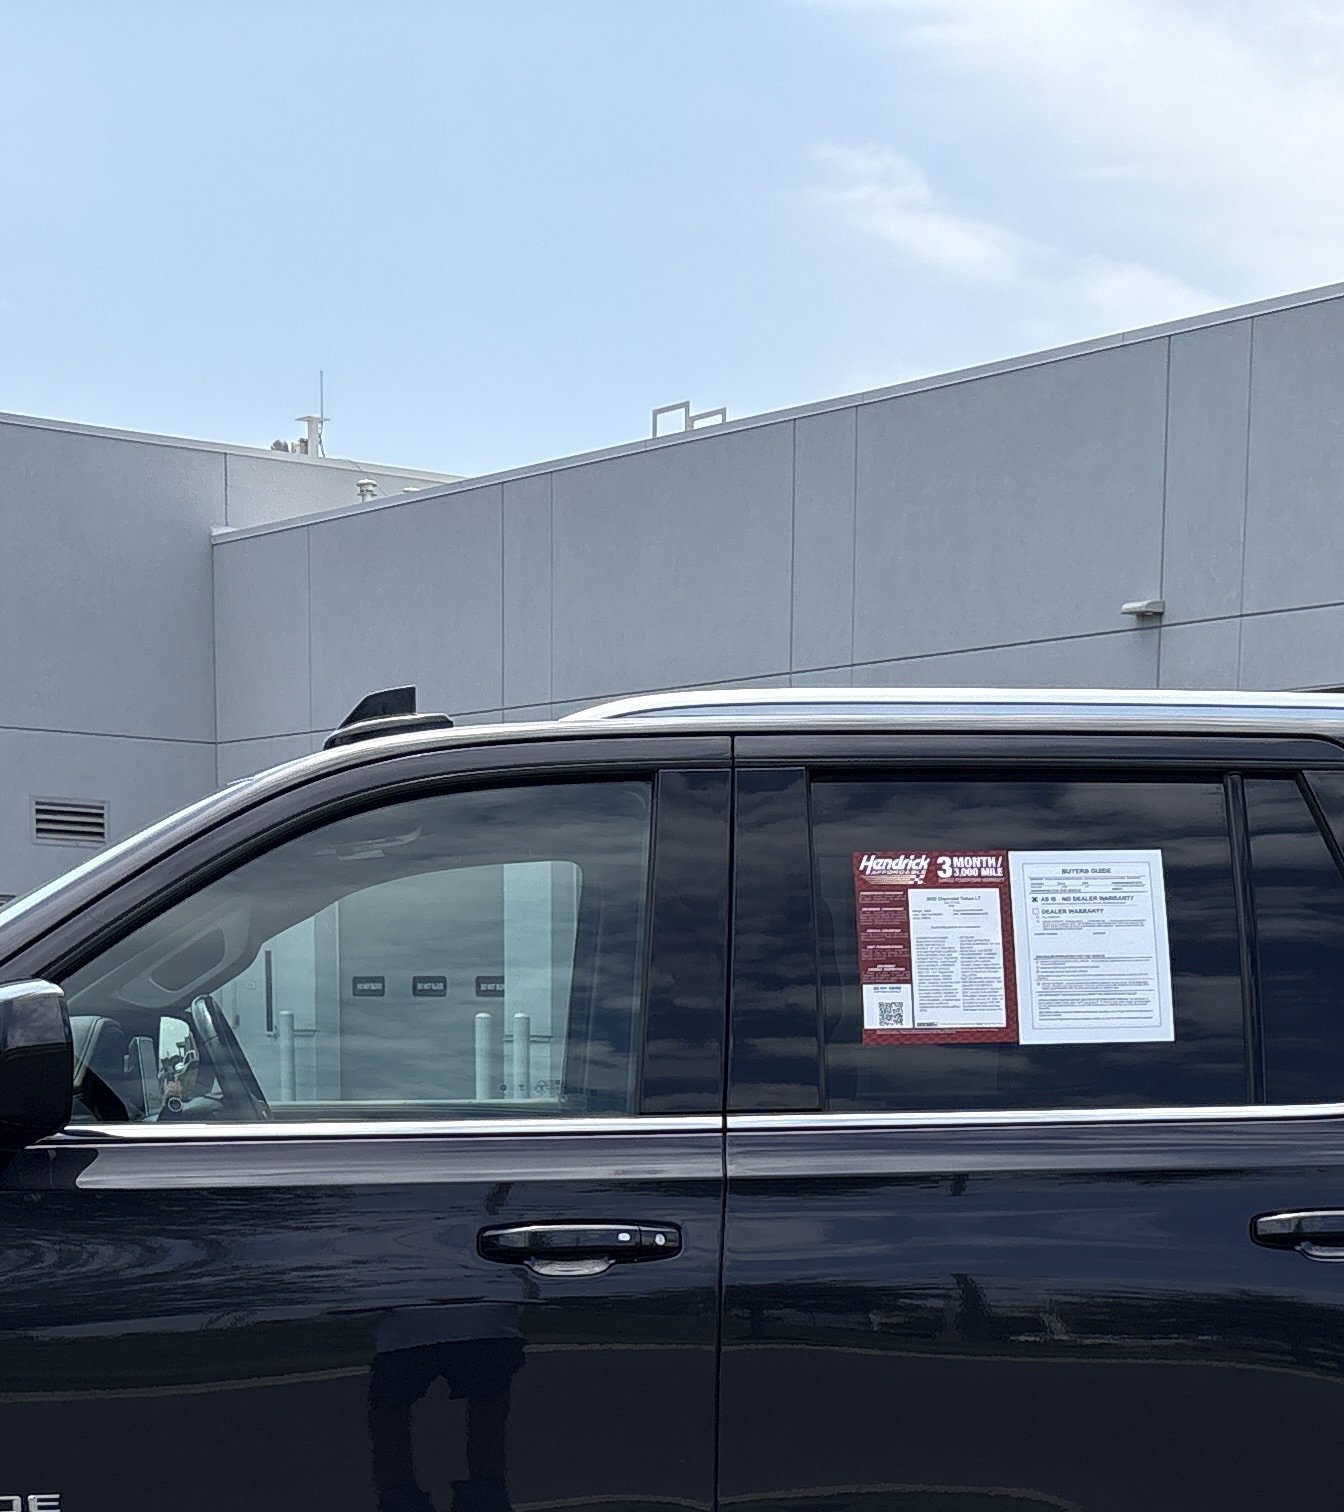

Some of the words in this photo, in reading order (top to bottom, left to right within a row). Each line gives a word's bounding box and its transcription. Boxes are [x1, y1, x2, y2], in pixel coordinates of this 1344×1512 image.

[859, 855, 930, 875] Hendrick
[937, 856, 952, 878] 3
[953, 856, 1003, 868] MONTH/
[981, 867, 1004, 877] MILE
